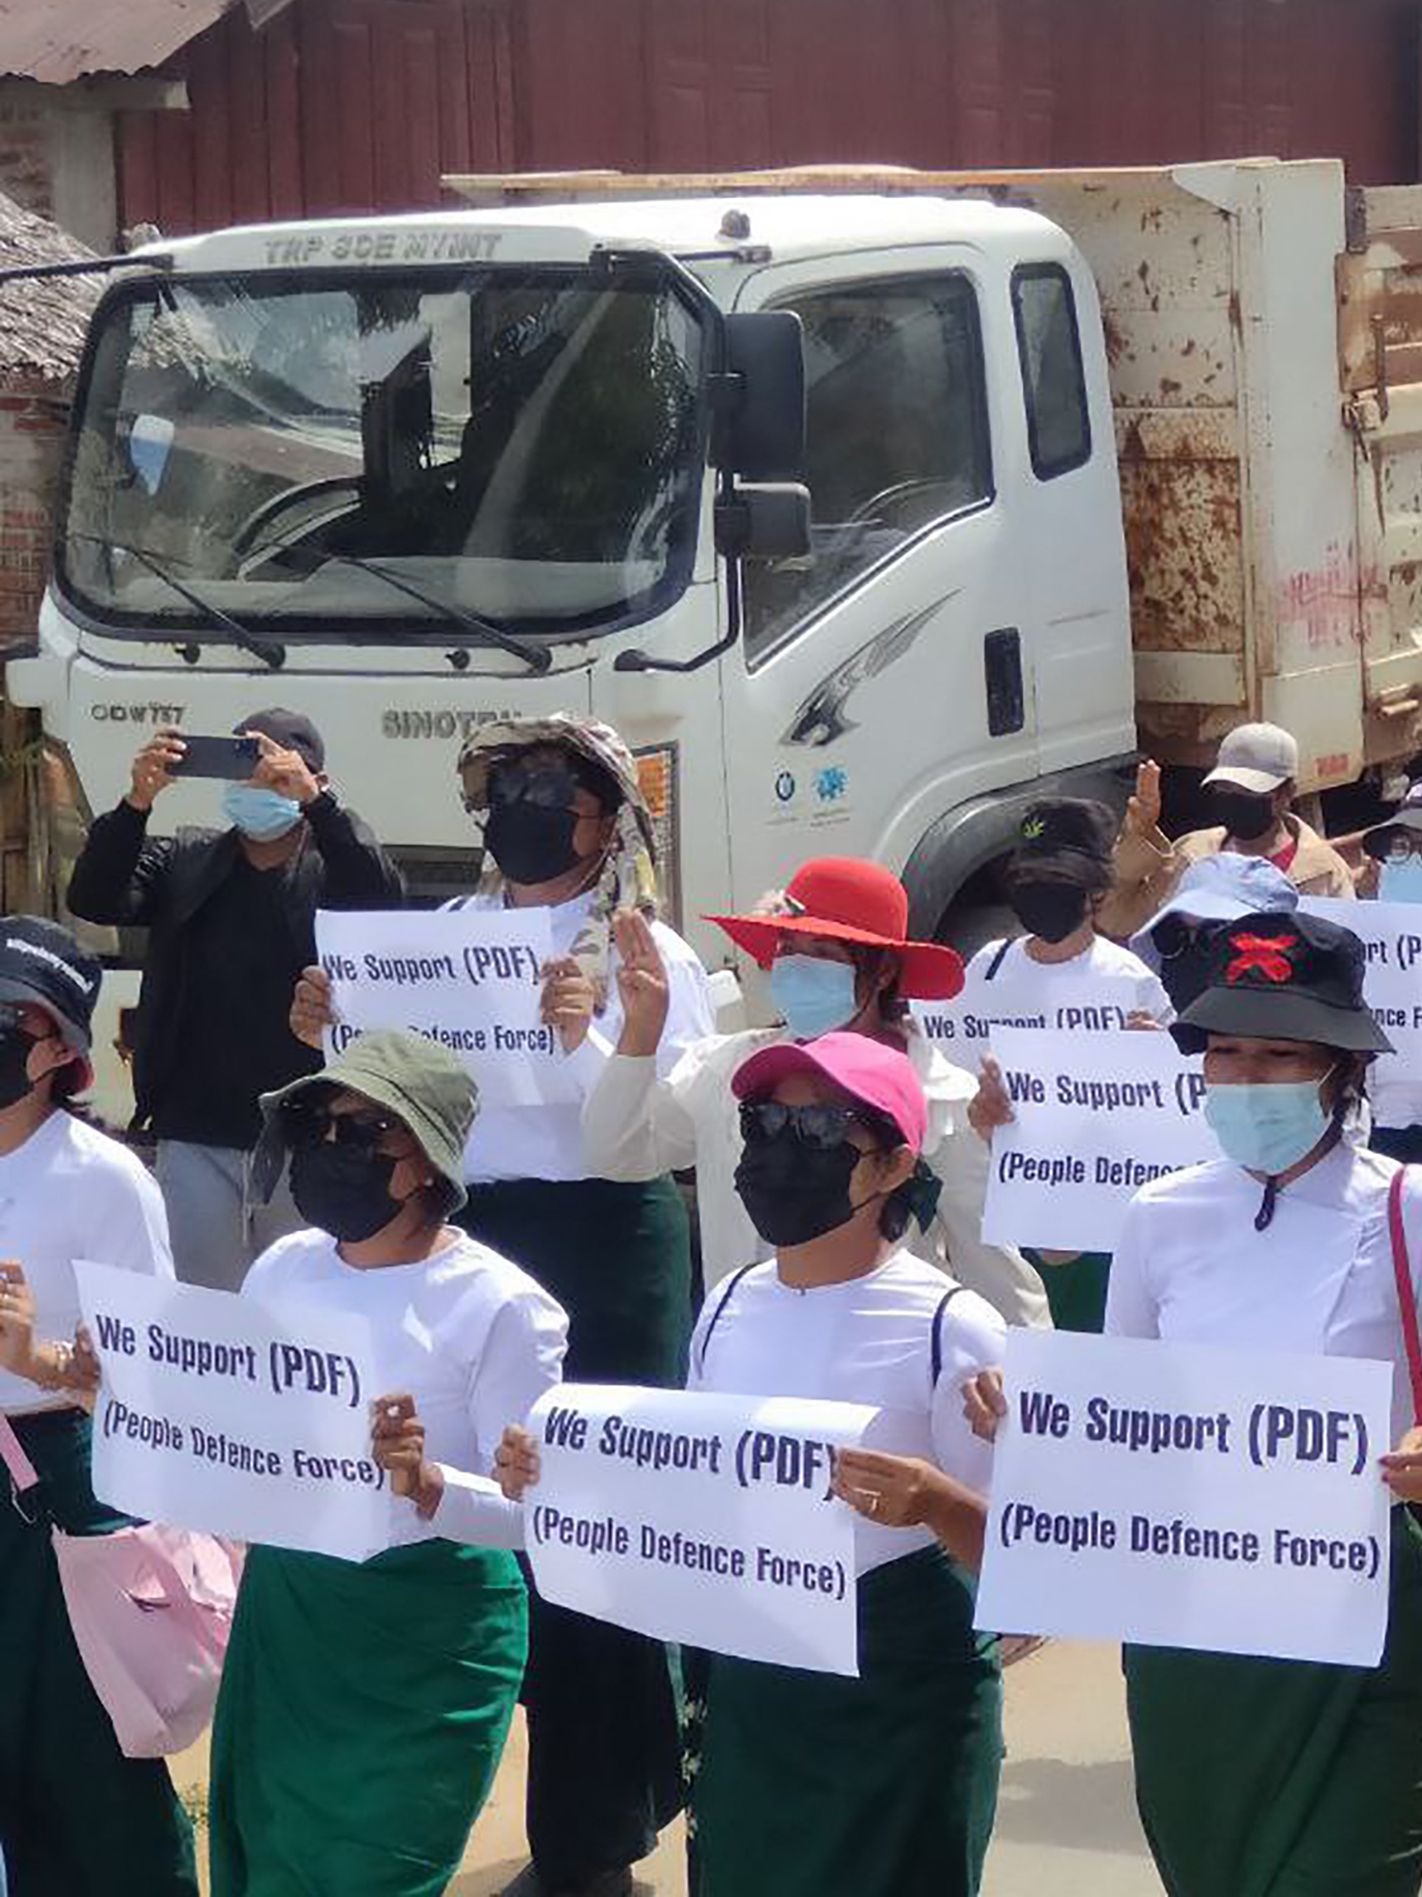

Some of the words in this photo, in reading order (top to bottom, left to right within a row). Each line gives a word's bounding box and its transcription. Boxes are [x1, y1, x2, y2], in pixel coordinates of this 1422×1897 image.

[321, 954, 358, 982] We
[364, 954, 456, 985] Support
[463, 945, 540, 985] (PDF)
[494, 1024, 555, 1055] Force)
[922, 1015, 955, 1039] We
[1005, 1071, 1046, 1103] We
[1056, 1073, 1164, 1110] Support
[999, 1151, 1086, 1186] (People
[95, 1313, 136, 1355] We
[148, 1324, 257, 1381] Support
[270, 1341, 361, 1408] (PDF)
[104, 1399, 184, 1451] (People
[190, 1426, 282, 1476] Defence
[293, 1449, 386, 1490] Force)
[544, 1406, 588, 1451] We
[599, 1414, 722, 1474] Support
[1019, 1389, 1070, 1438] We
[1086, 1396, 1231, 1454] Support
[1248, 1403, 1369, 1476] (PDF)
[532, 1505, 630, 1555] (People
[640, 1524, 746, 1577] Defence
[756, 1547, 846, 1601] Force)
[1000, 1502, 1117, 1553] (People
[1131, 1514, 1260, 1564] Defence
[1273, 1528, 1381, 1579] Force)
